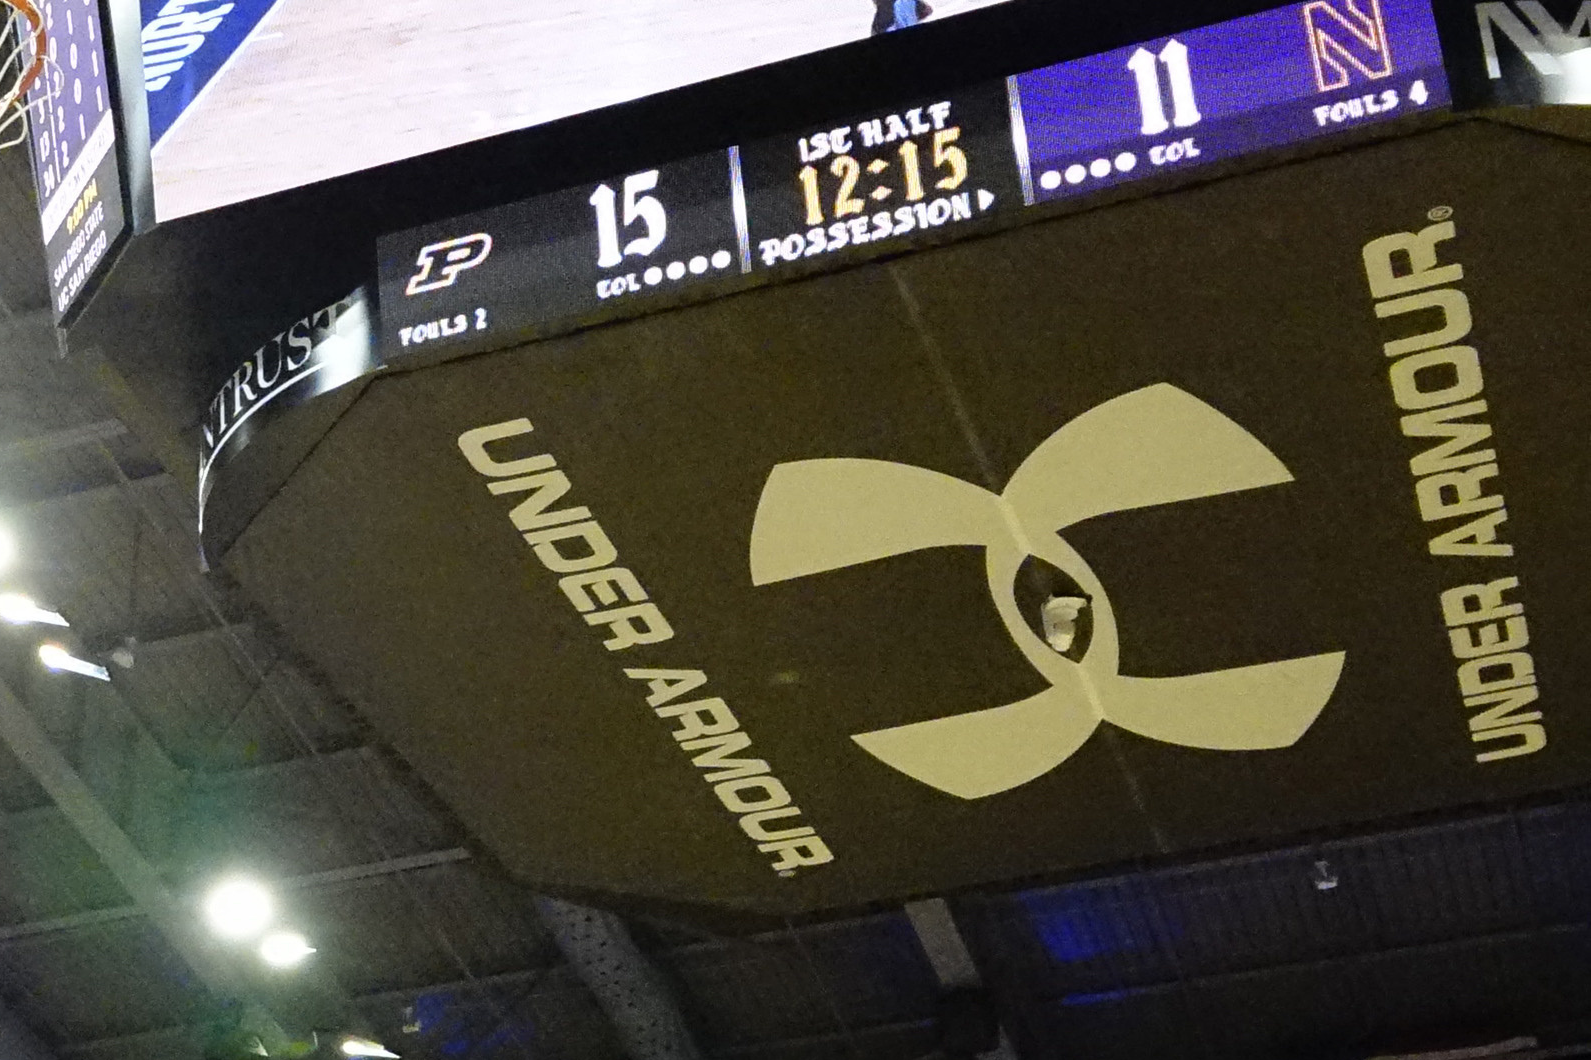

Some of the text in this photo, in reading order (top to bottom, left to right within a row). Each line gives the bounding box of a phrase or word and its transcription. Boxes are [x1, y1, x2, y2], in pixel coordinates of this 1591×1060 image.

[857, 101, 951, 148] HALF
[1127, 37, 1202, 136] 11
[1313, 80, 1428, 127] FOULS 4
[589, 170, 667, 268] 15
[798, 127, 968, 226] 12:15
[758, 192, 971, 266] POSSESSION
[398, 308, 488, 347] FOULS 2
[1361, 219, 1547, 763] UNDER ARMOUR
[458, 417, 835, 872] UNDER ARMOUR
